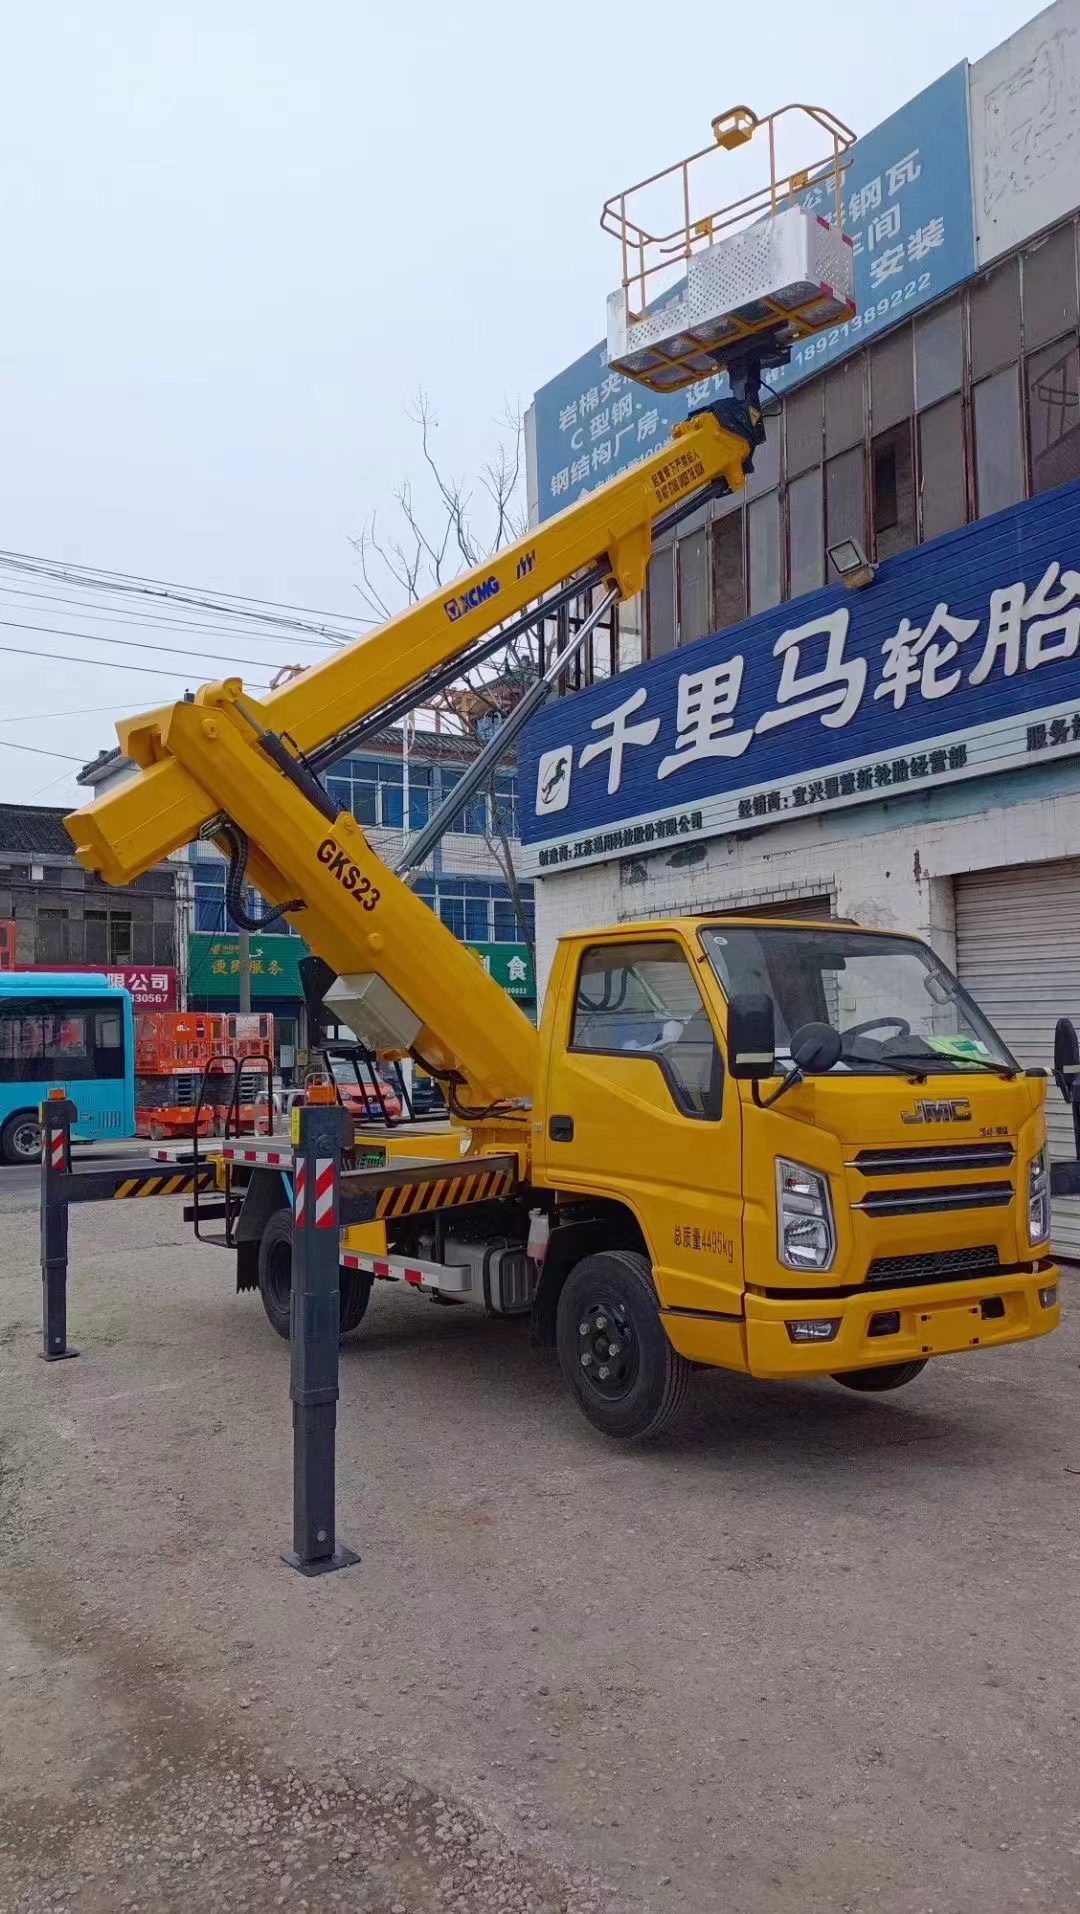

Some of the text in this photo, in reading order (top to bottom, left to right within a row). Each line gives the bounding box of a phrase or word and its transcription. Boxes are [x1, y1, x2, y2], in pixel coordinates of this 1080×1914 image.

[871, 216, 945, 289] 安装
[795, 272, 931, 364] 18921389222
[559, 373, 634, 432] 岩棉夹
[460, 575, 500, 612] XCMG
[578, 561, 1080, 795] 千里马轮胎
[317, 839, 381, 911] GKS23
[901, 1098, 973, 1125] JMC
